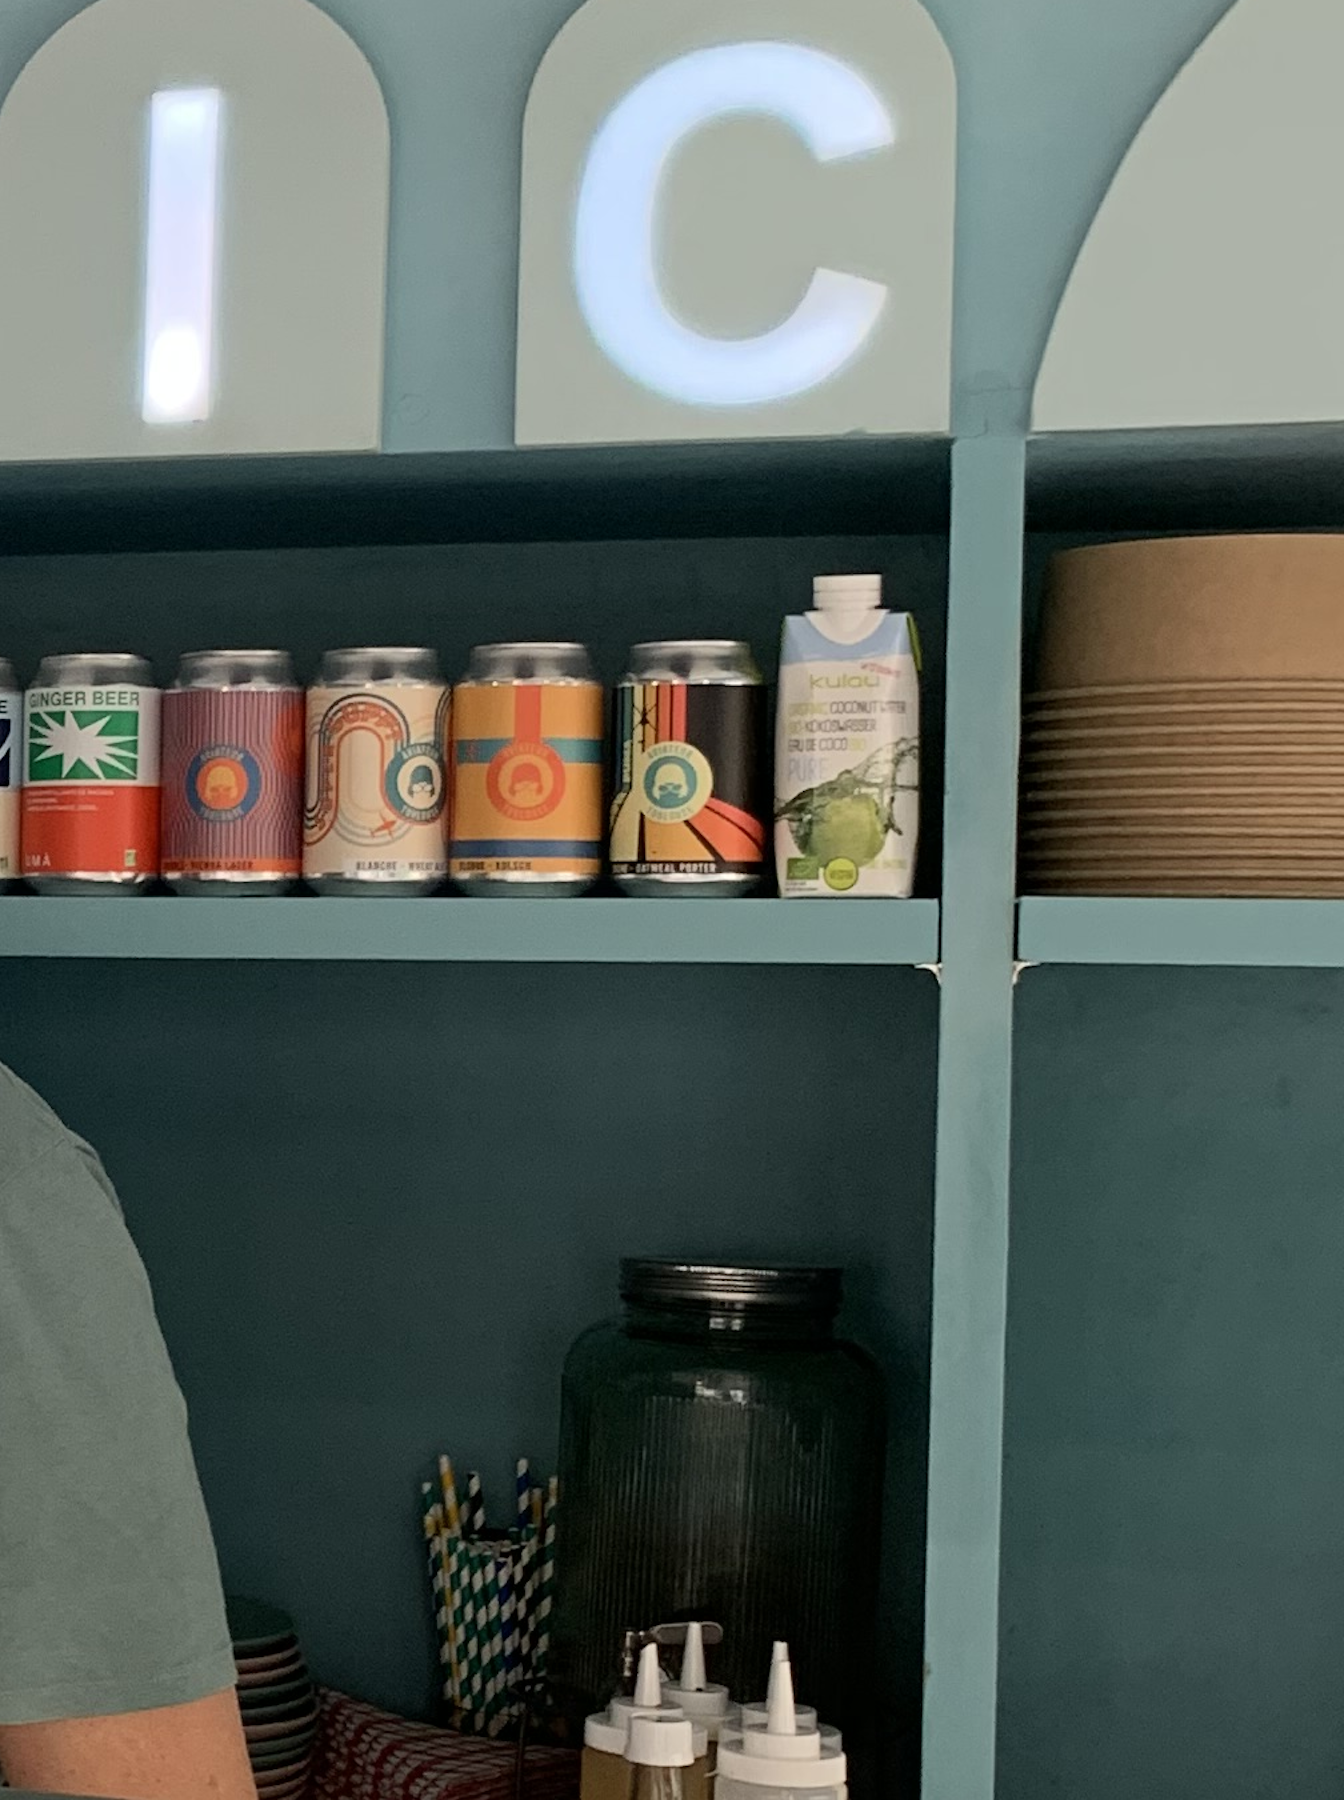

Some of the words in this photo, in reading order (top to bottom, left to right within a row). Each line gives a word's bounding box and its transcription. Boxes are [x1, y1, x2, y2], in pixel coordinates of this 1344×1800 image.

[809, 674, 880, 688] kulau
[29, 692, 86, 707] GINGER
[93, 691, 139, 706] BEER
[830, 701, 876, 714] COCONUT
[819, 738, 848, 751] COCO
[356, 861, 397, 871] BLANCHE
[678, 863, 717, 873] PORTER
